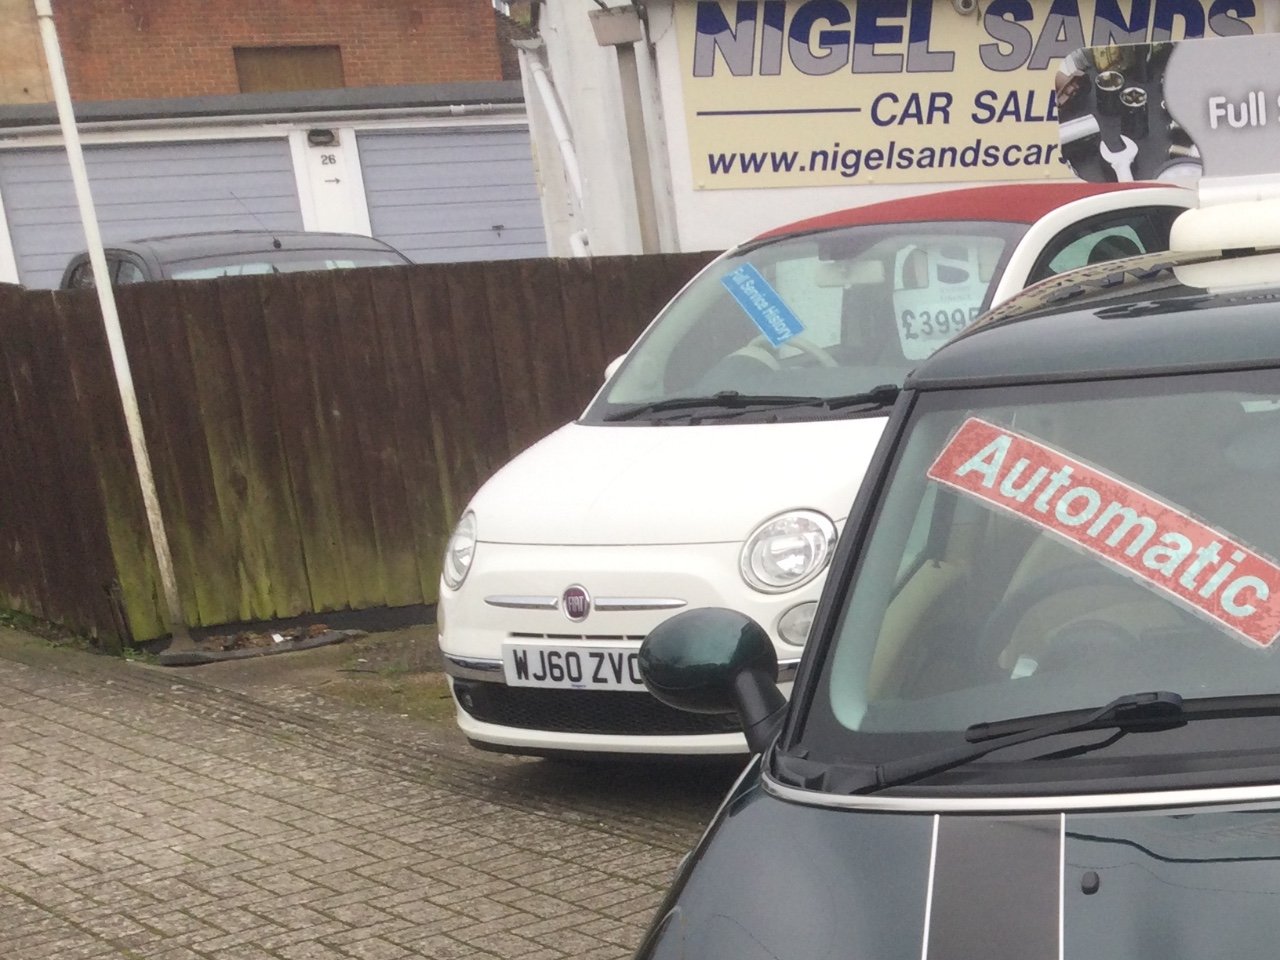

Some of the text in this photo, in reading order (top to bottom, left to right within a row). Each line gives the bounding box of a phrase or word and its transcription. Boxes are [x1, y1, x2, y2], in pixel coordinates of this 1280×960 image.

[692, 0, 956, 77] NIGEL
[870, 91, 953, 127] CAR
[1208, 90, 1267, 129] Full
[320, 154, 337, 166] 26
[707, 138, 1068, 178] www.nigelsandscar
[954, 434, 1270, 619] Automatic
[567, 595, 584, 612] FIAT
[513, 649, 582, 682] WJ60
